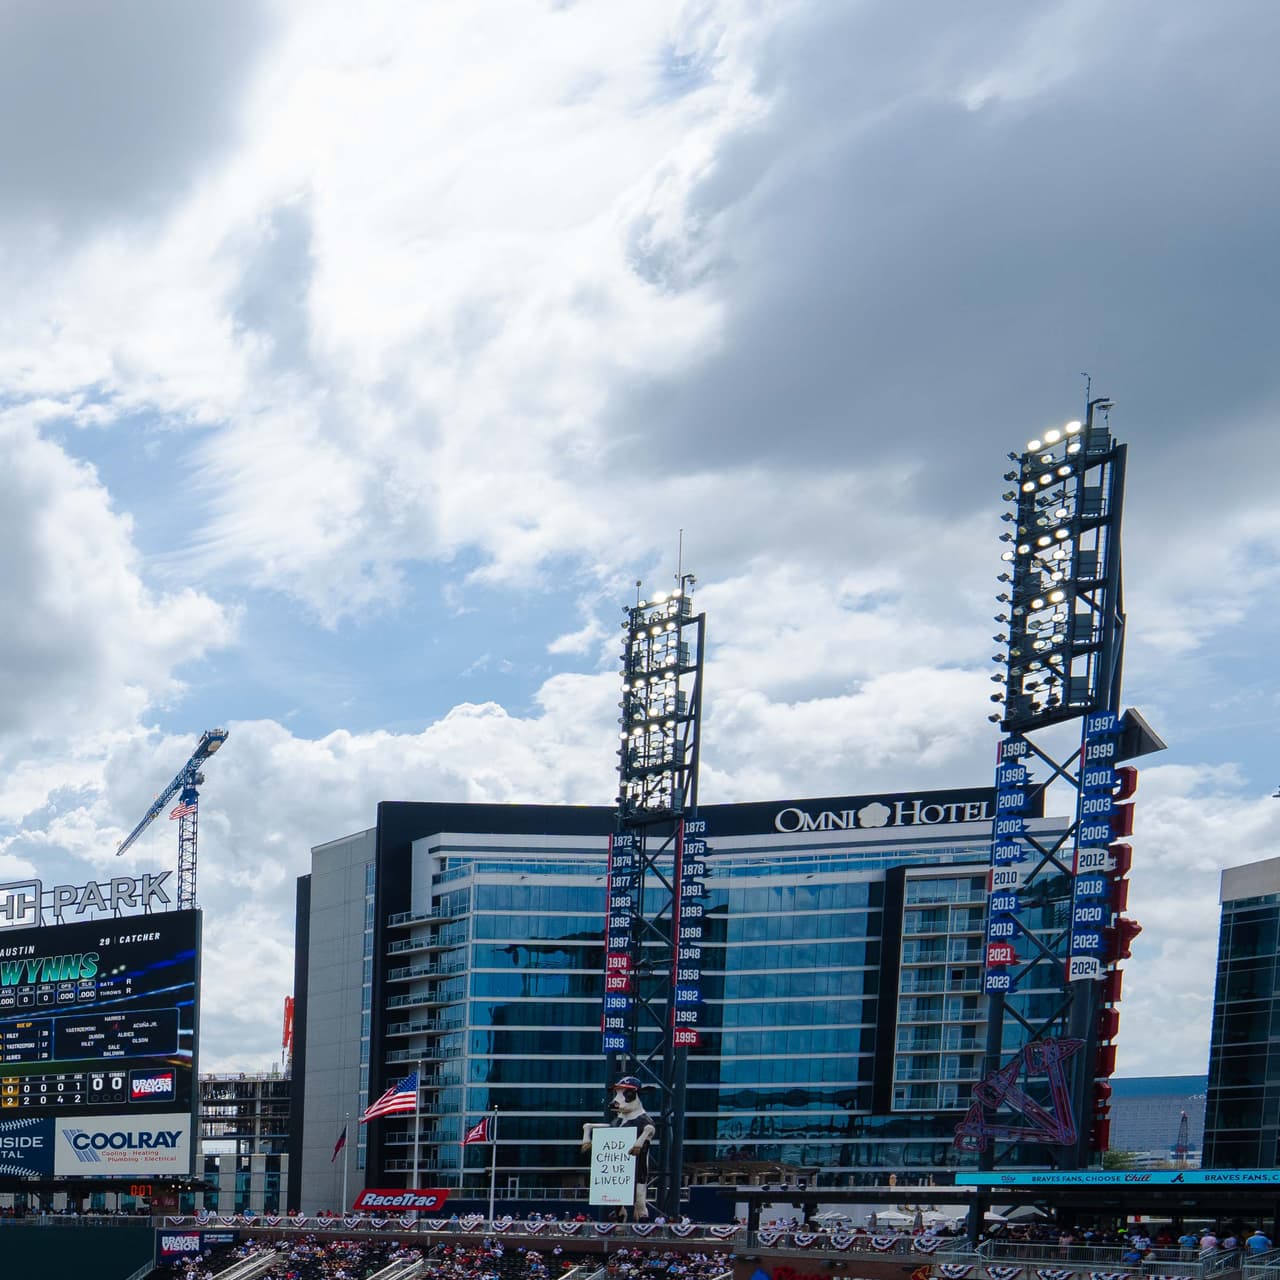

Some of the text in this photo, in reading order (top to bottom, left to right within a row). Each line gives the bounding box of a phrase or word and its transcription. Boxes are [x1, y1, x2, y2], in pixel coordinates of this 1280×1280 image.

[1089, 716, 1115, 730] 1997
[1087, 743, 1114, 757] 1999
[1085, 771, 1112, 784] 2001
[1084, 799, 1111, 812] 2003
[774, 808, 855, 834] OMNI
[685, 822, 705, 832] 1873
[1082, 826, 1108, 840] 2005
[684, 843, 704, 853] 1875
[1080, 853, 1105, 867] 2012
[683, 864, 704, 875] 1878
[682, 885, 702, 896] 1891
[1077, 881, 1102, 894] 2018
[54, 871, 173, 917] PARK
[681, 906, 702, 917] 1893
[1075, 907, 1101, 921] 2020
[120, 932, 160, 943] CATCHER
[680, 928, 701, 938] 1898
[1073, 934, 1099, 948] 2022
[0, 946, 34, 957] AUSTIN
[680, 948, 700, 959] 1948
[1, 952, 99, 986] WYNNS
[1071, 961, 1098, 974] 2024
[678, 970, 699, 980] 1958
[678, 990, 698, 1001] 1982
[676, 1011, 697, 1022] 1992
[675, 1032, 696, 1043] 1995
[93, 1078, 122, 1090] 0 0
[133, 1078, 172, 1087] BRAVES
[133, 1084, 171, 1092] VISION
[72, 1130, 183, 1150] COOLRAY
[603, 1141, 625, 1150] ADD
[596, 1152, 630, 1162] CHIKIN
[601, 1165, 624, 1173] 2 UR
[595, 1176, 630, 1185] LINEUP
[361, 1193, 437, 1207] RaceTrac
[162, 1236, 200, 1245] BRAVES
[163, 1241, 200, 1251] VISION
